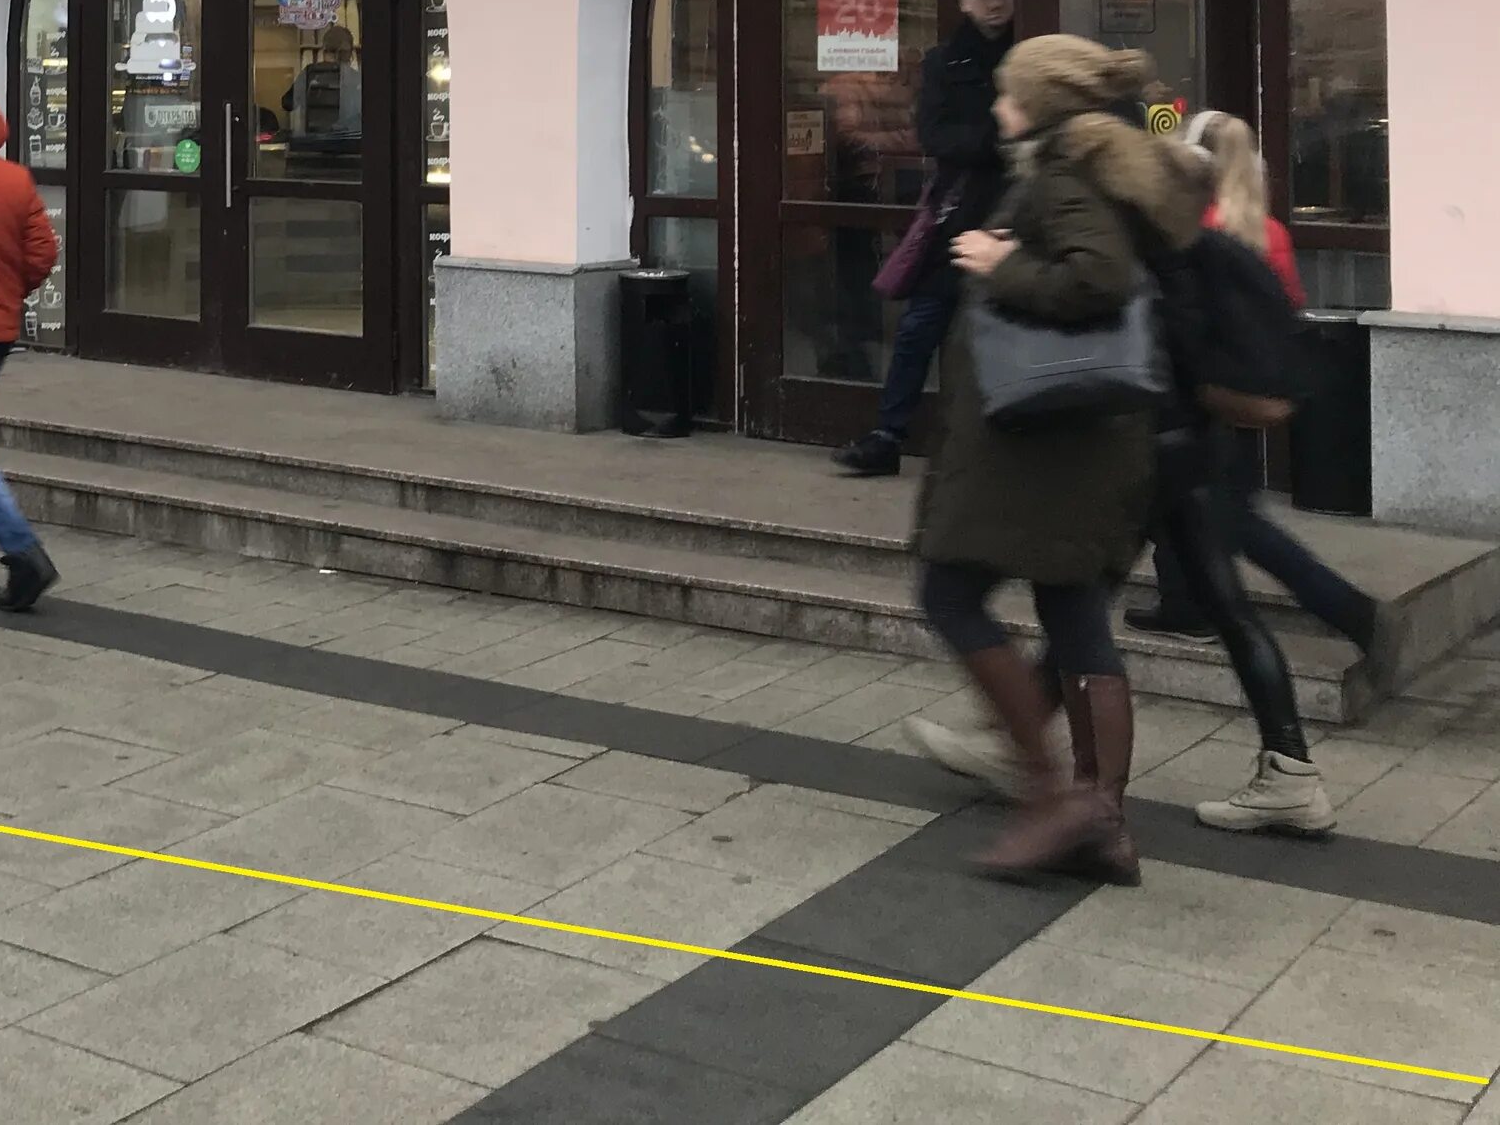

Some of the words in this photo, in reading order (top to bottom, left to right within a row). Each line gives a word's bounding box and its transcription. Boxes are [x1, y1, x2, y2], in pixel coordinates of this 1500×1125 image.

[427, 28, 448, 39] коф
[427, 92, 450, 103] коф
[427, 156, 450, 168] коф
[429, 231, 450, 243] коф
